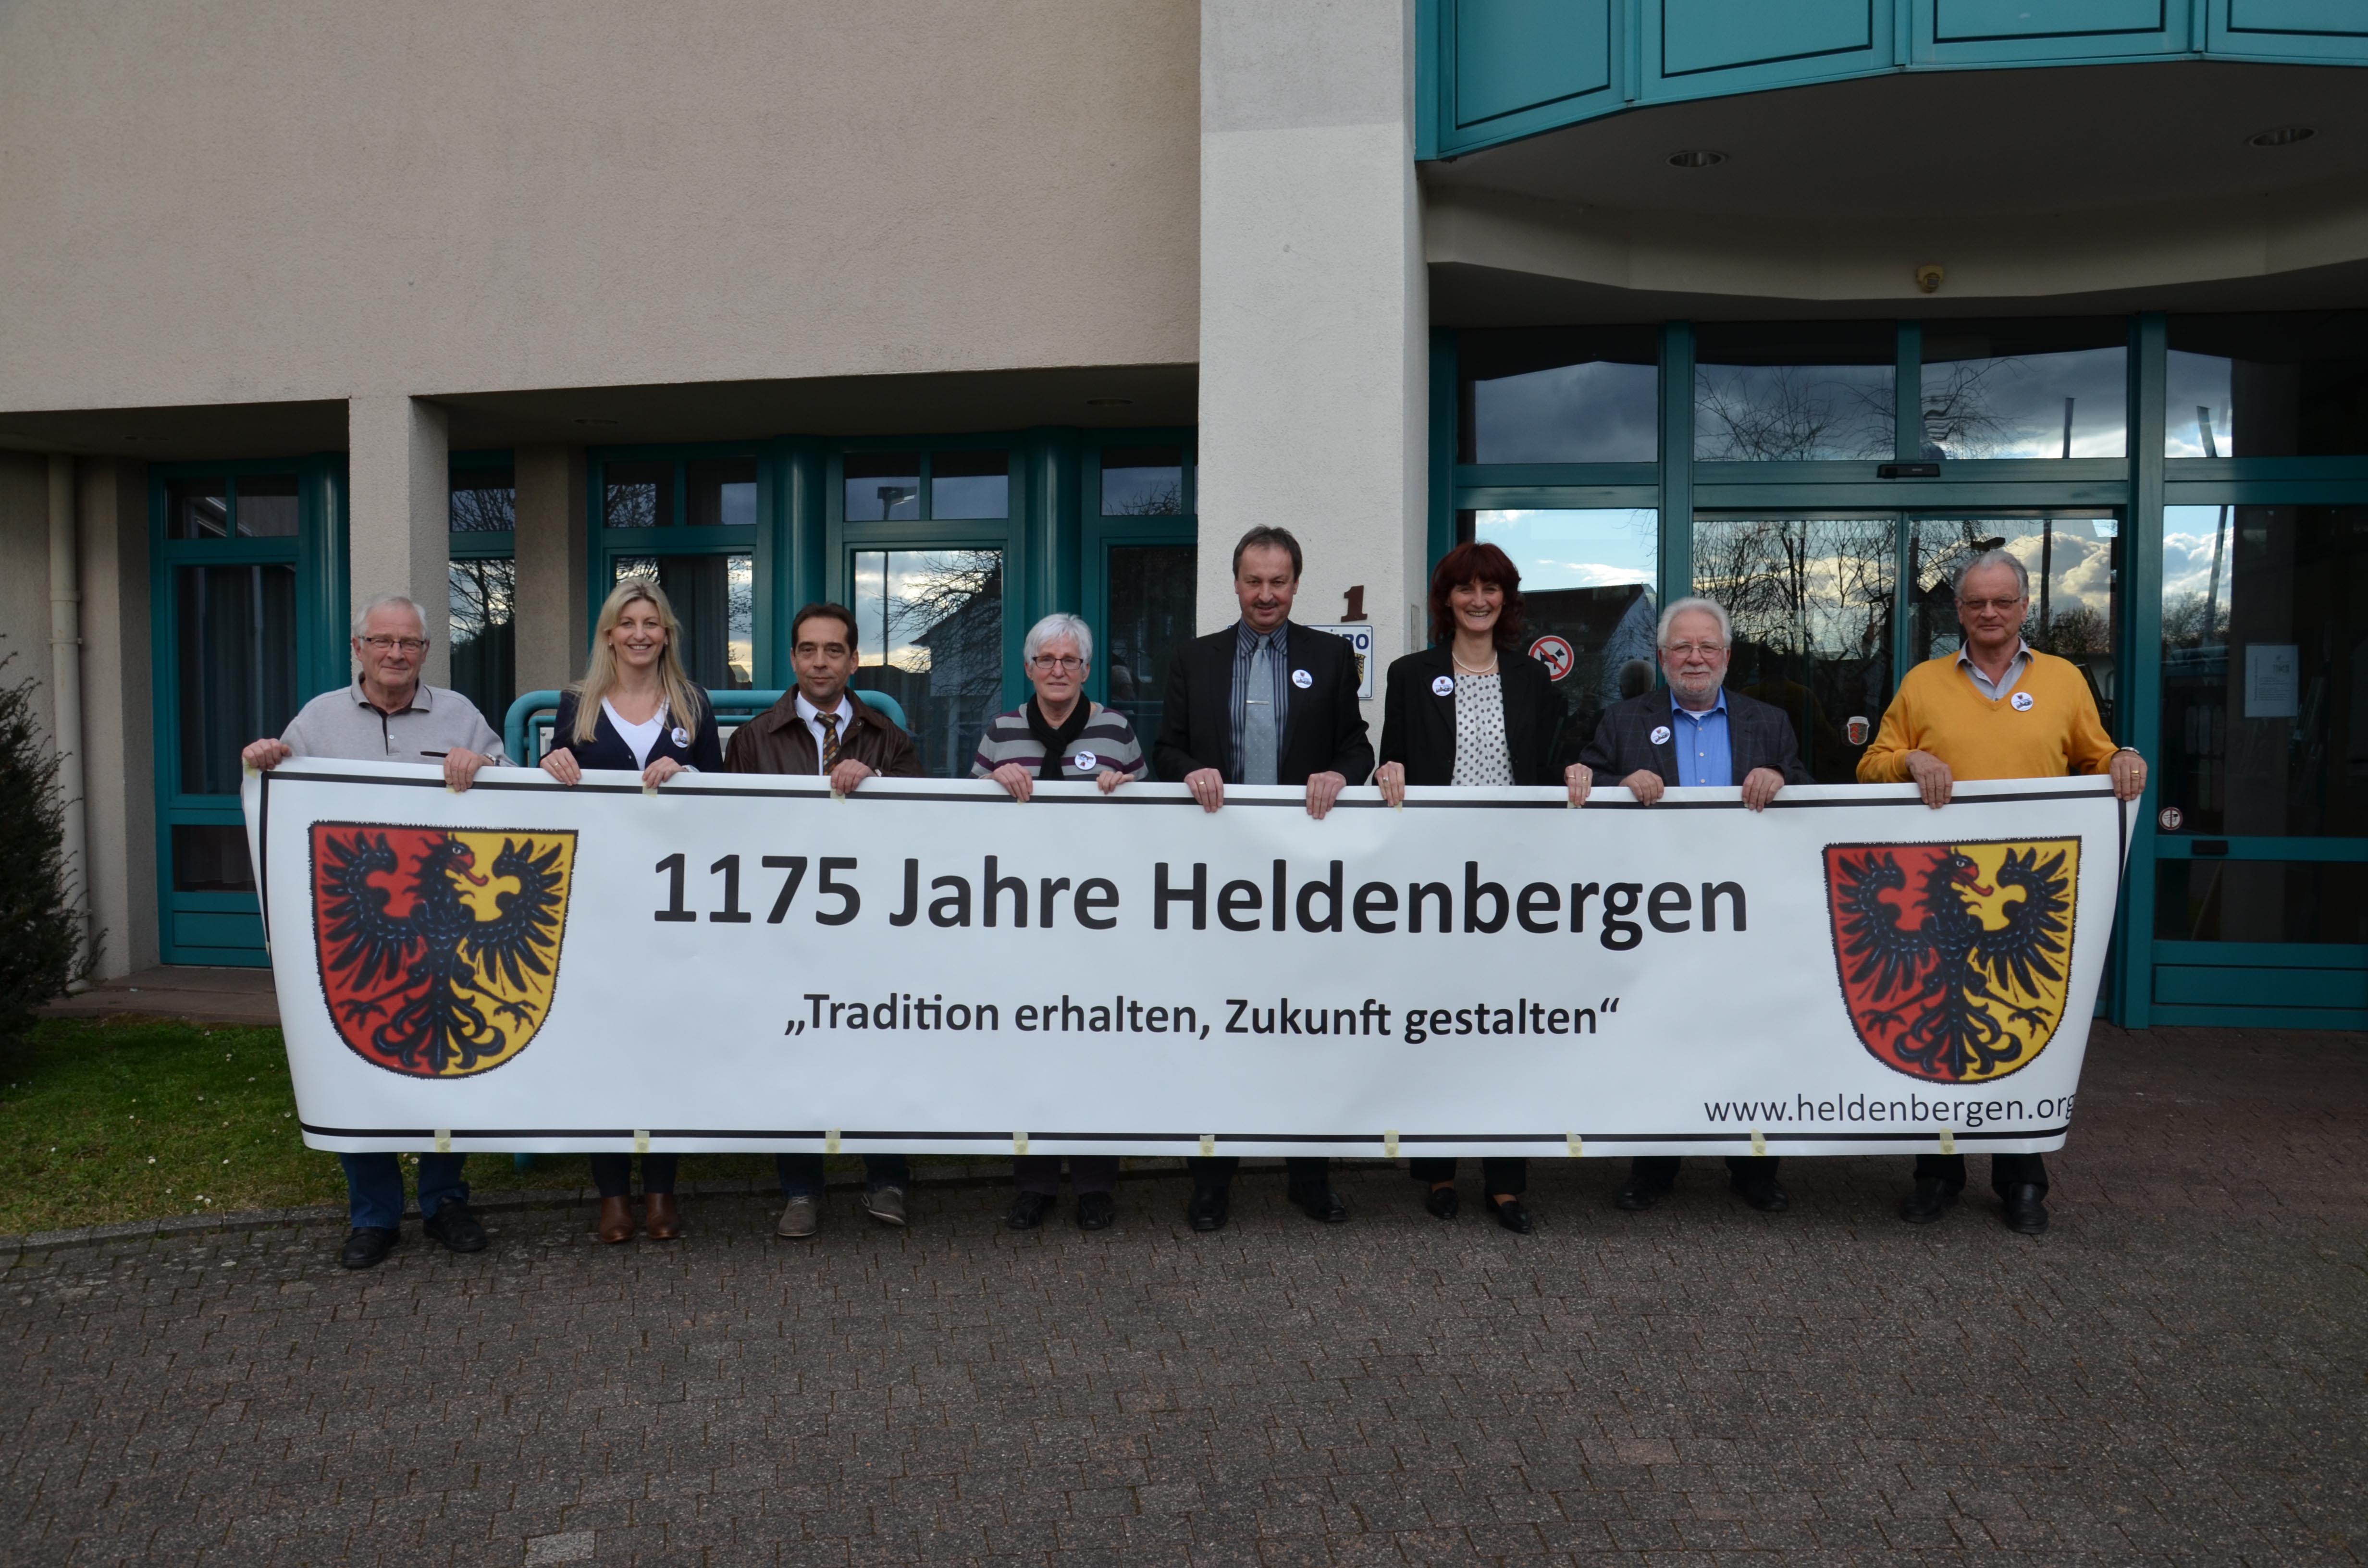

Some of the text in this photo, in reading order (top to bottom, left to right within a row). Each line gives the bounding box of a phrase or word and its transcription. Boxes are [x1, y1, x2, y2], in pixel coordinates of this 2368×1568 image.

[1341, 585, 1368, 623] 1
[654, 853, 1747, 951] 1175 Jahre Heldenbergen
[785, 992, 1620, 1044] „Tradition erhalten, Zukunft gestalten“
[1704, 1093, 2075, 1127] www.heldenbergen.org
